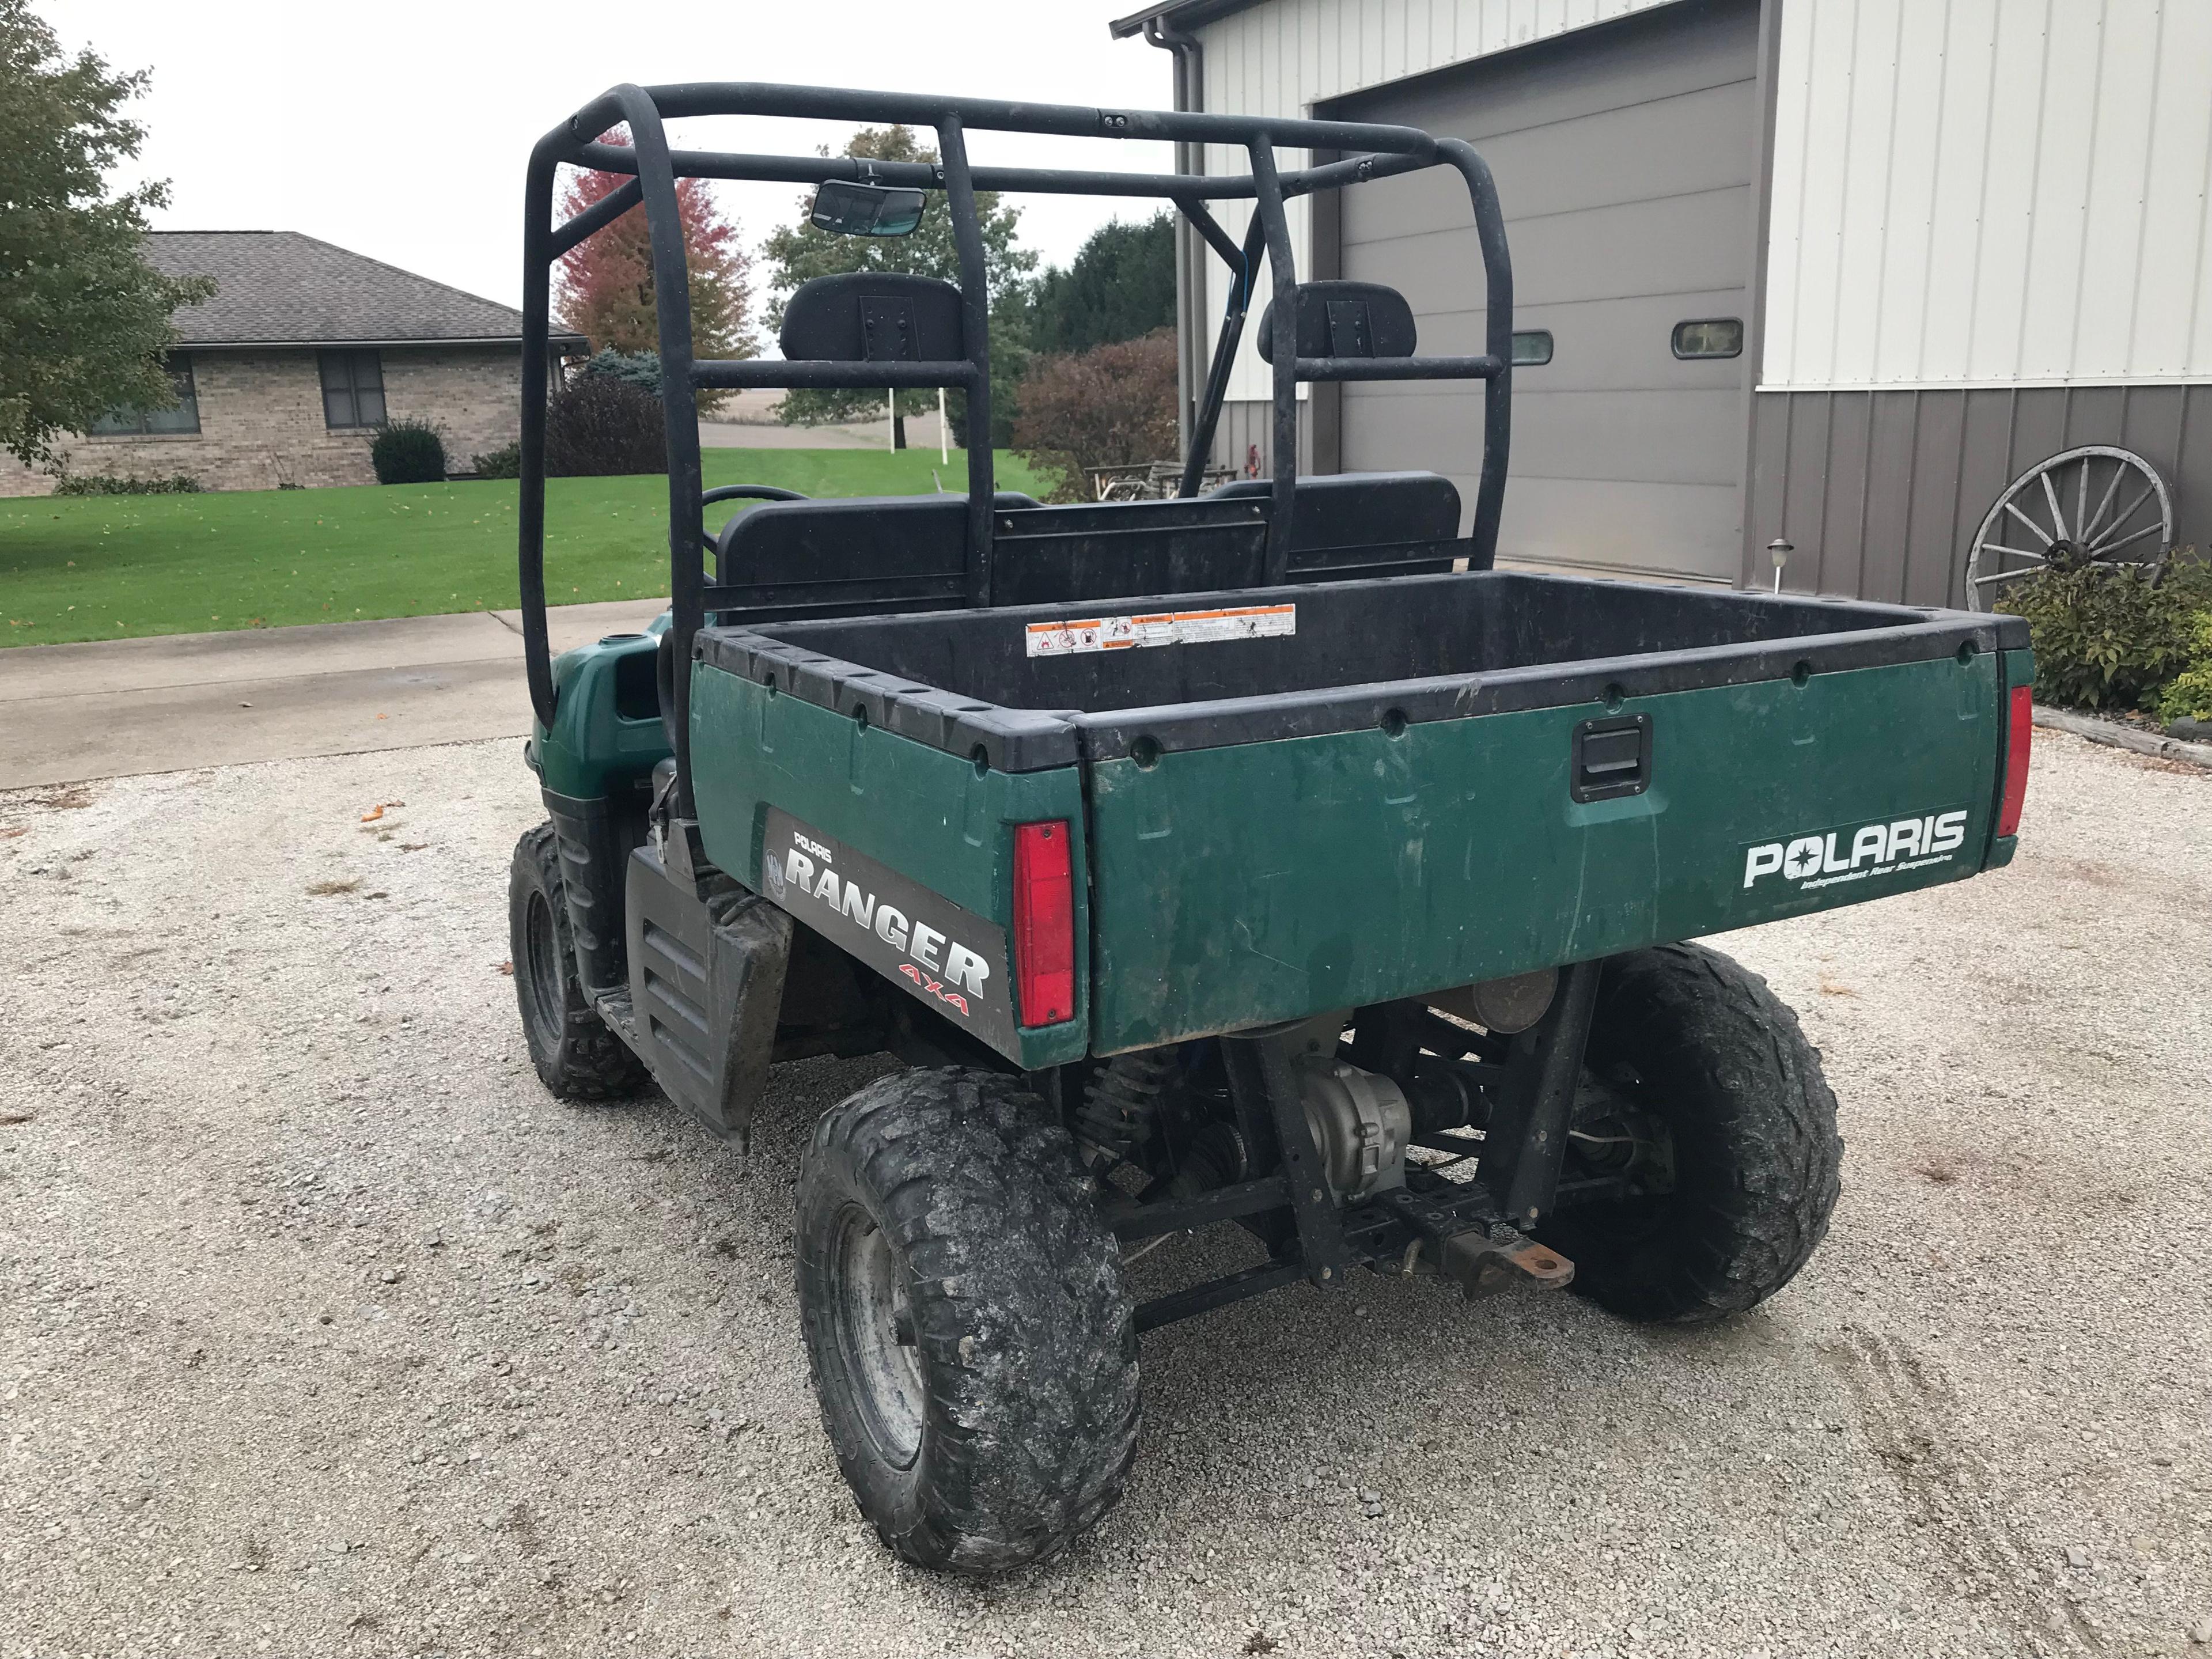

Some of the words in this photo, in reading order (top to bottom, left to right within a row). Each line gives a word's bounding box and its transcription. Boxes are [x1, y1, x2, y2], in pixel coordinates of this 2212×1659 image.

[794, 831, 832, 863] POLARIS
[1743, 810, 1968, 888] POLARIS
[1800, 869, 1868, 890] Independent
[1869, 865, 1896, 876] Rear
[785, 847, 990, 999] RANGER
